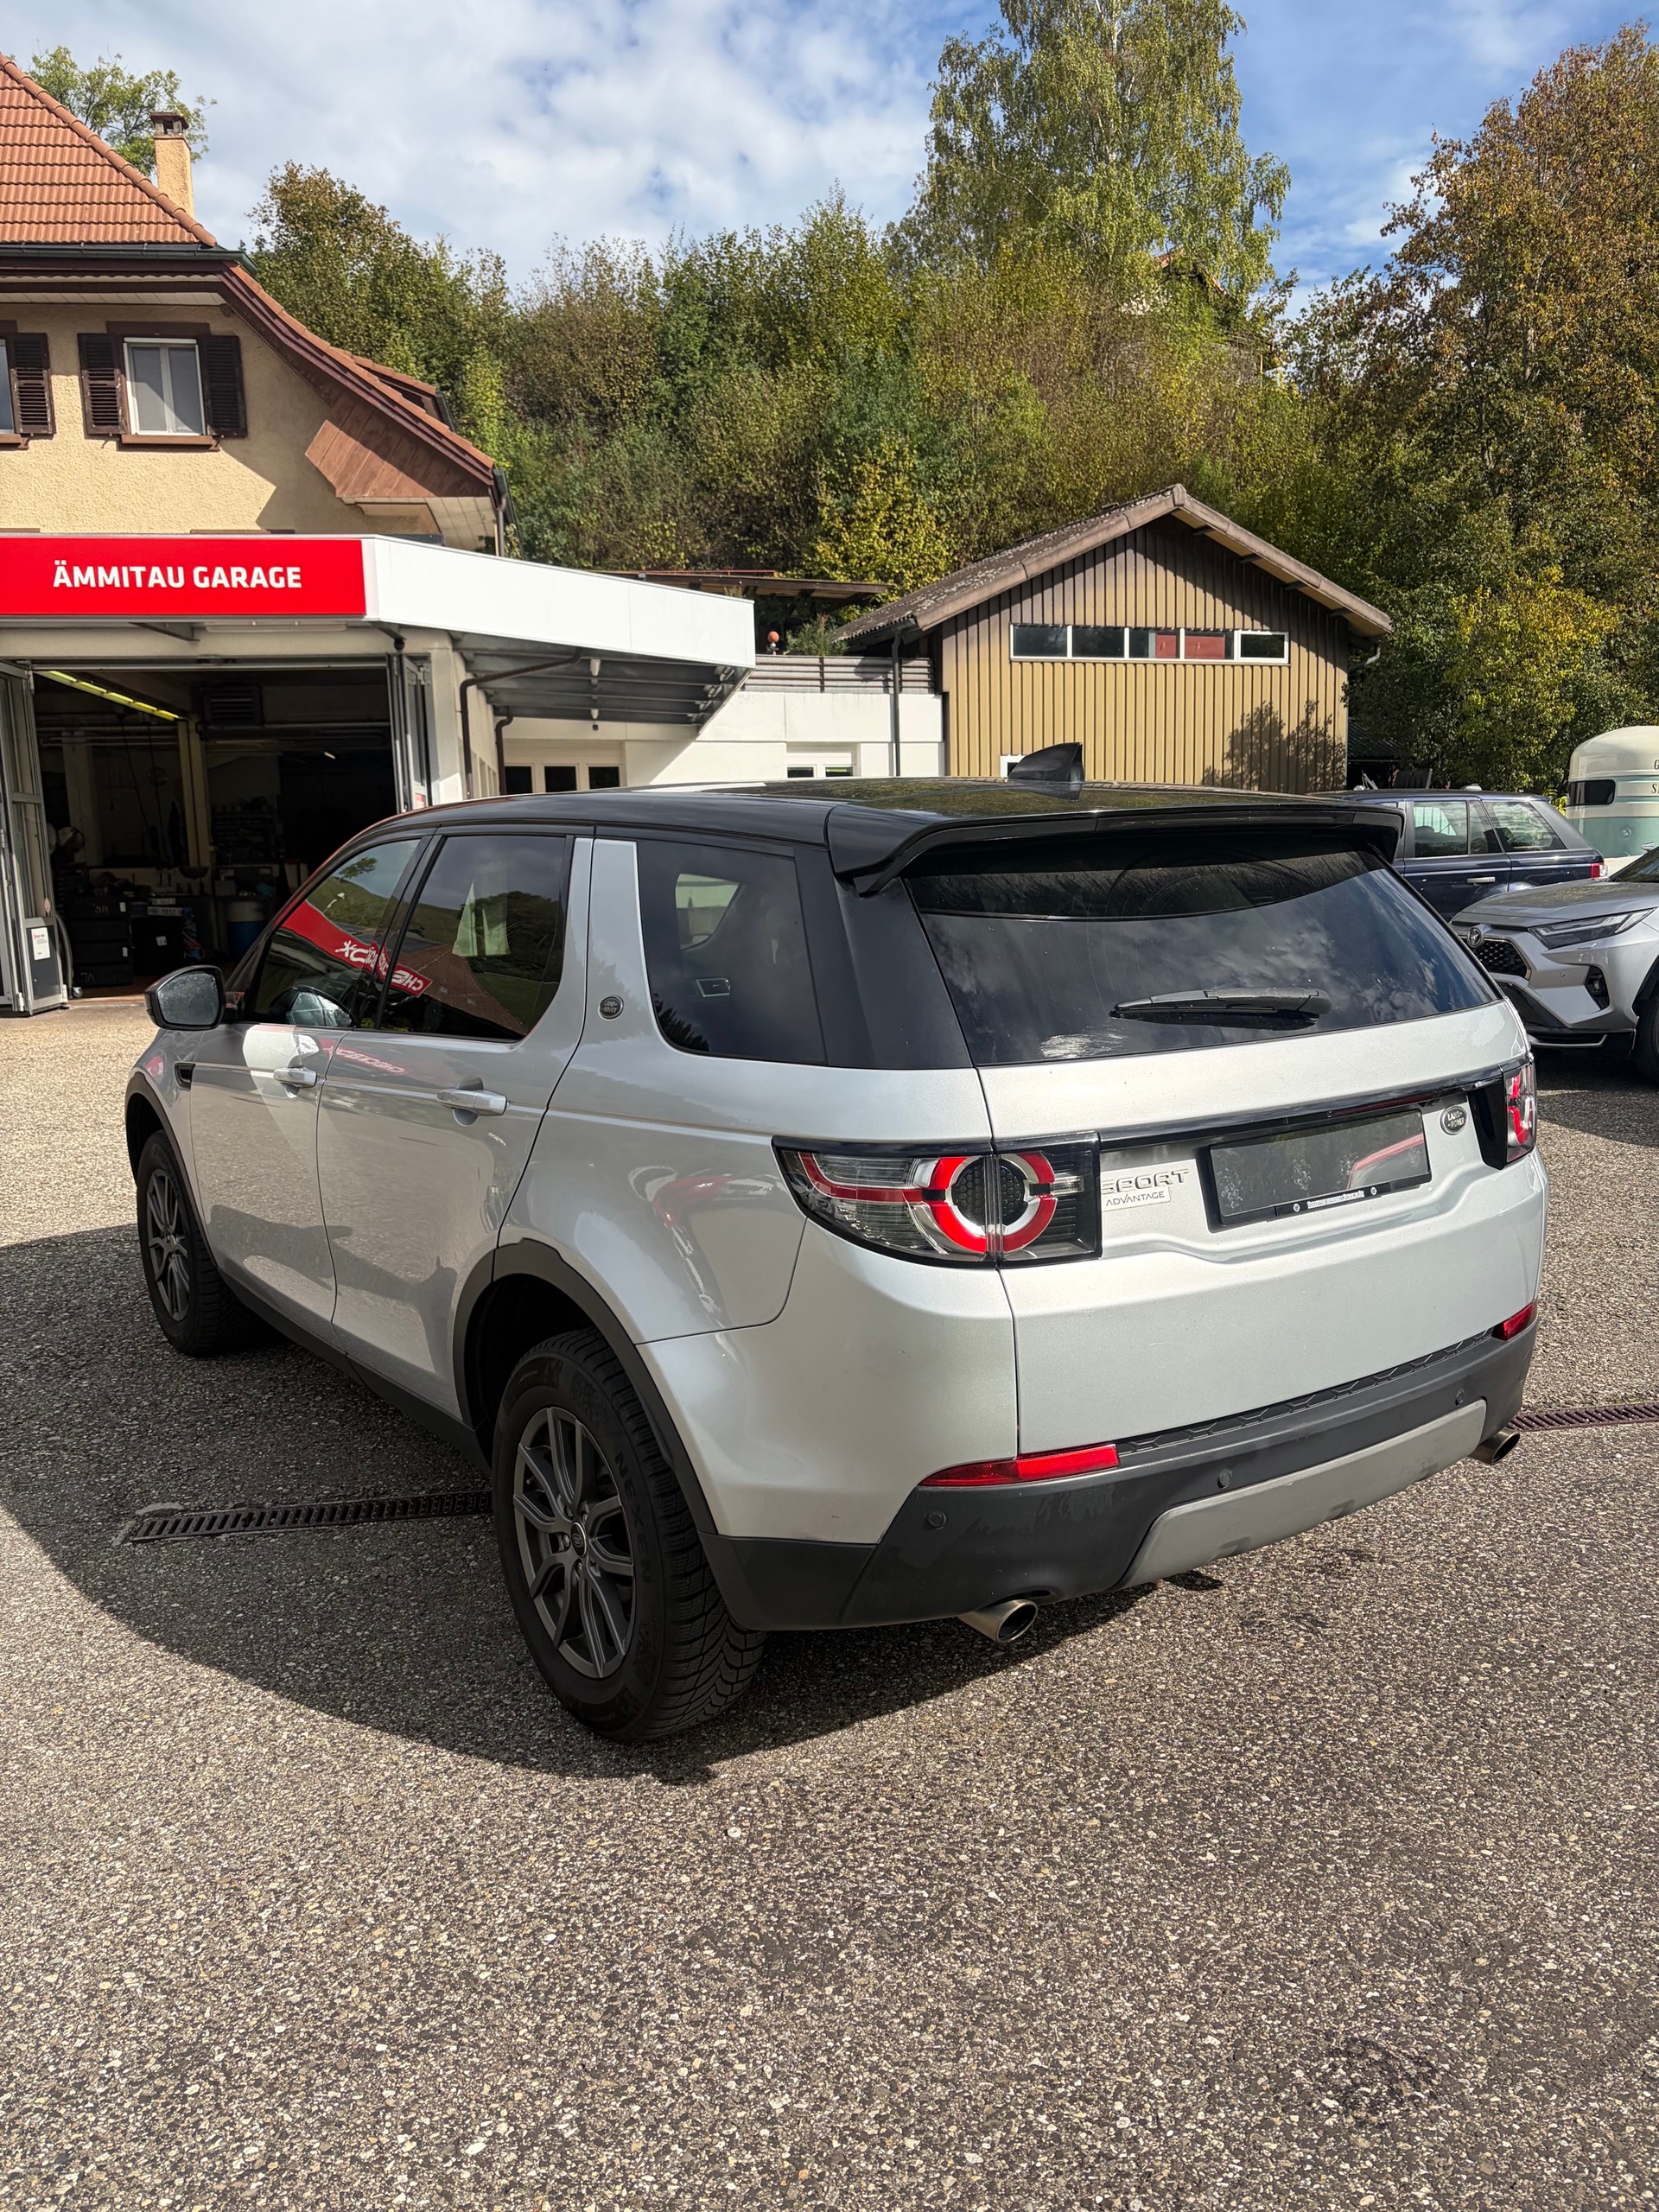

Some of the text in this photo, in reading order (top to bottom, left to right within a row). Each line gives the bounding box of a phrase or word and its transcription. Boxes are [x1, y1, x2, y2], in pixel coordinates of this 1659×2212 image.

[54, 559, 302, 589] ÄMMITAU GARAGE
[1447, 1110, 1460, 1122] LAND
[1450, 1117, 1465, 1128] ROVER
[1101, 1168, 1189, 1195] SPORT
[1106, 1192, 1165, 1206] ADVANTAGE
[614, 1452, 652, 1584] NEXEN
